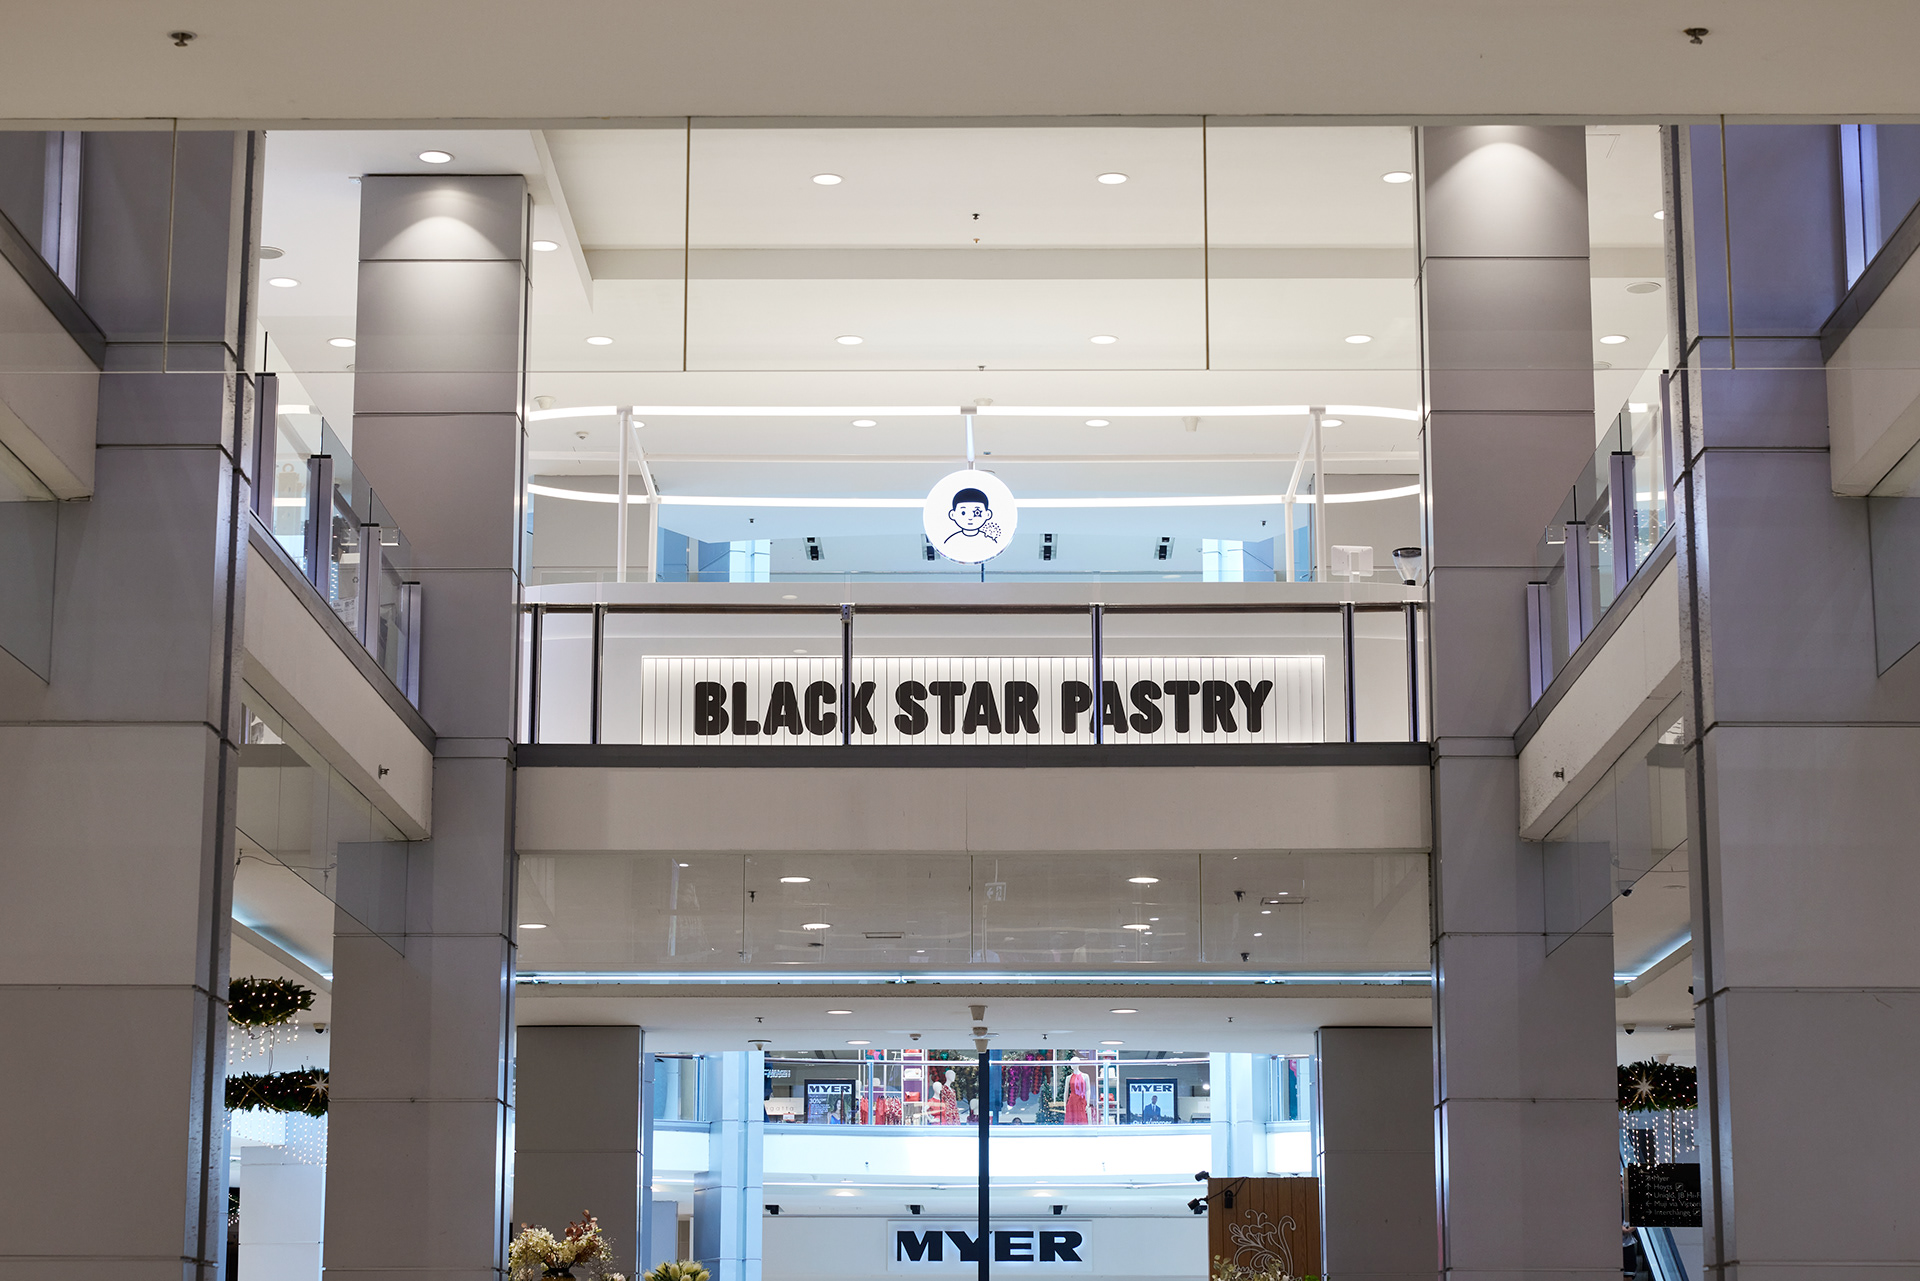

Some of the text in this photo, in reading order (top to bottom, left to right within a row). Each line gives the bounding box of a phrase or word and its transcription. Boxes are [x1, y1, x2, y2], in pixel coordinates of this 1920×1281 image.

[694, 680, 1273, 736] BLACK STAR PASTRY
[808, 1085, 851, 1093] MYER
[1131, 1084, 1172, 1092] MYER
[1653, 1174, 1670, 1183] Myer
[897, 1231, 1083, 1262] MYER
